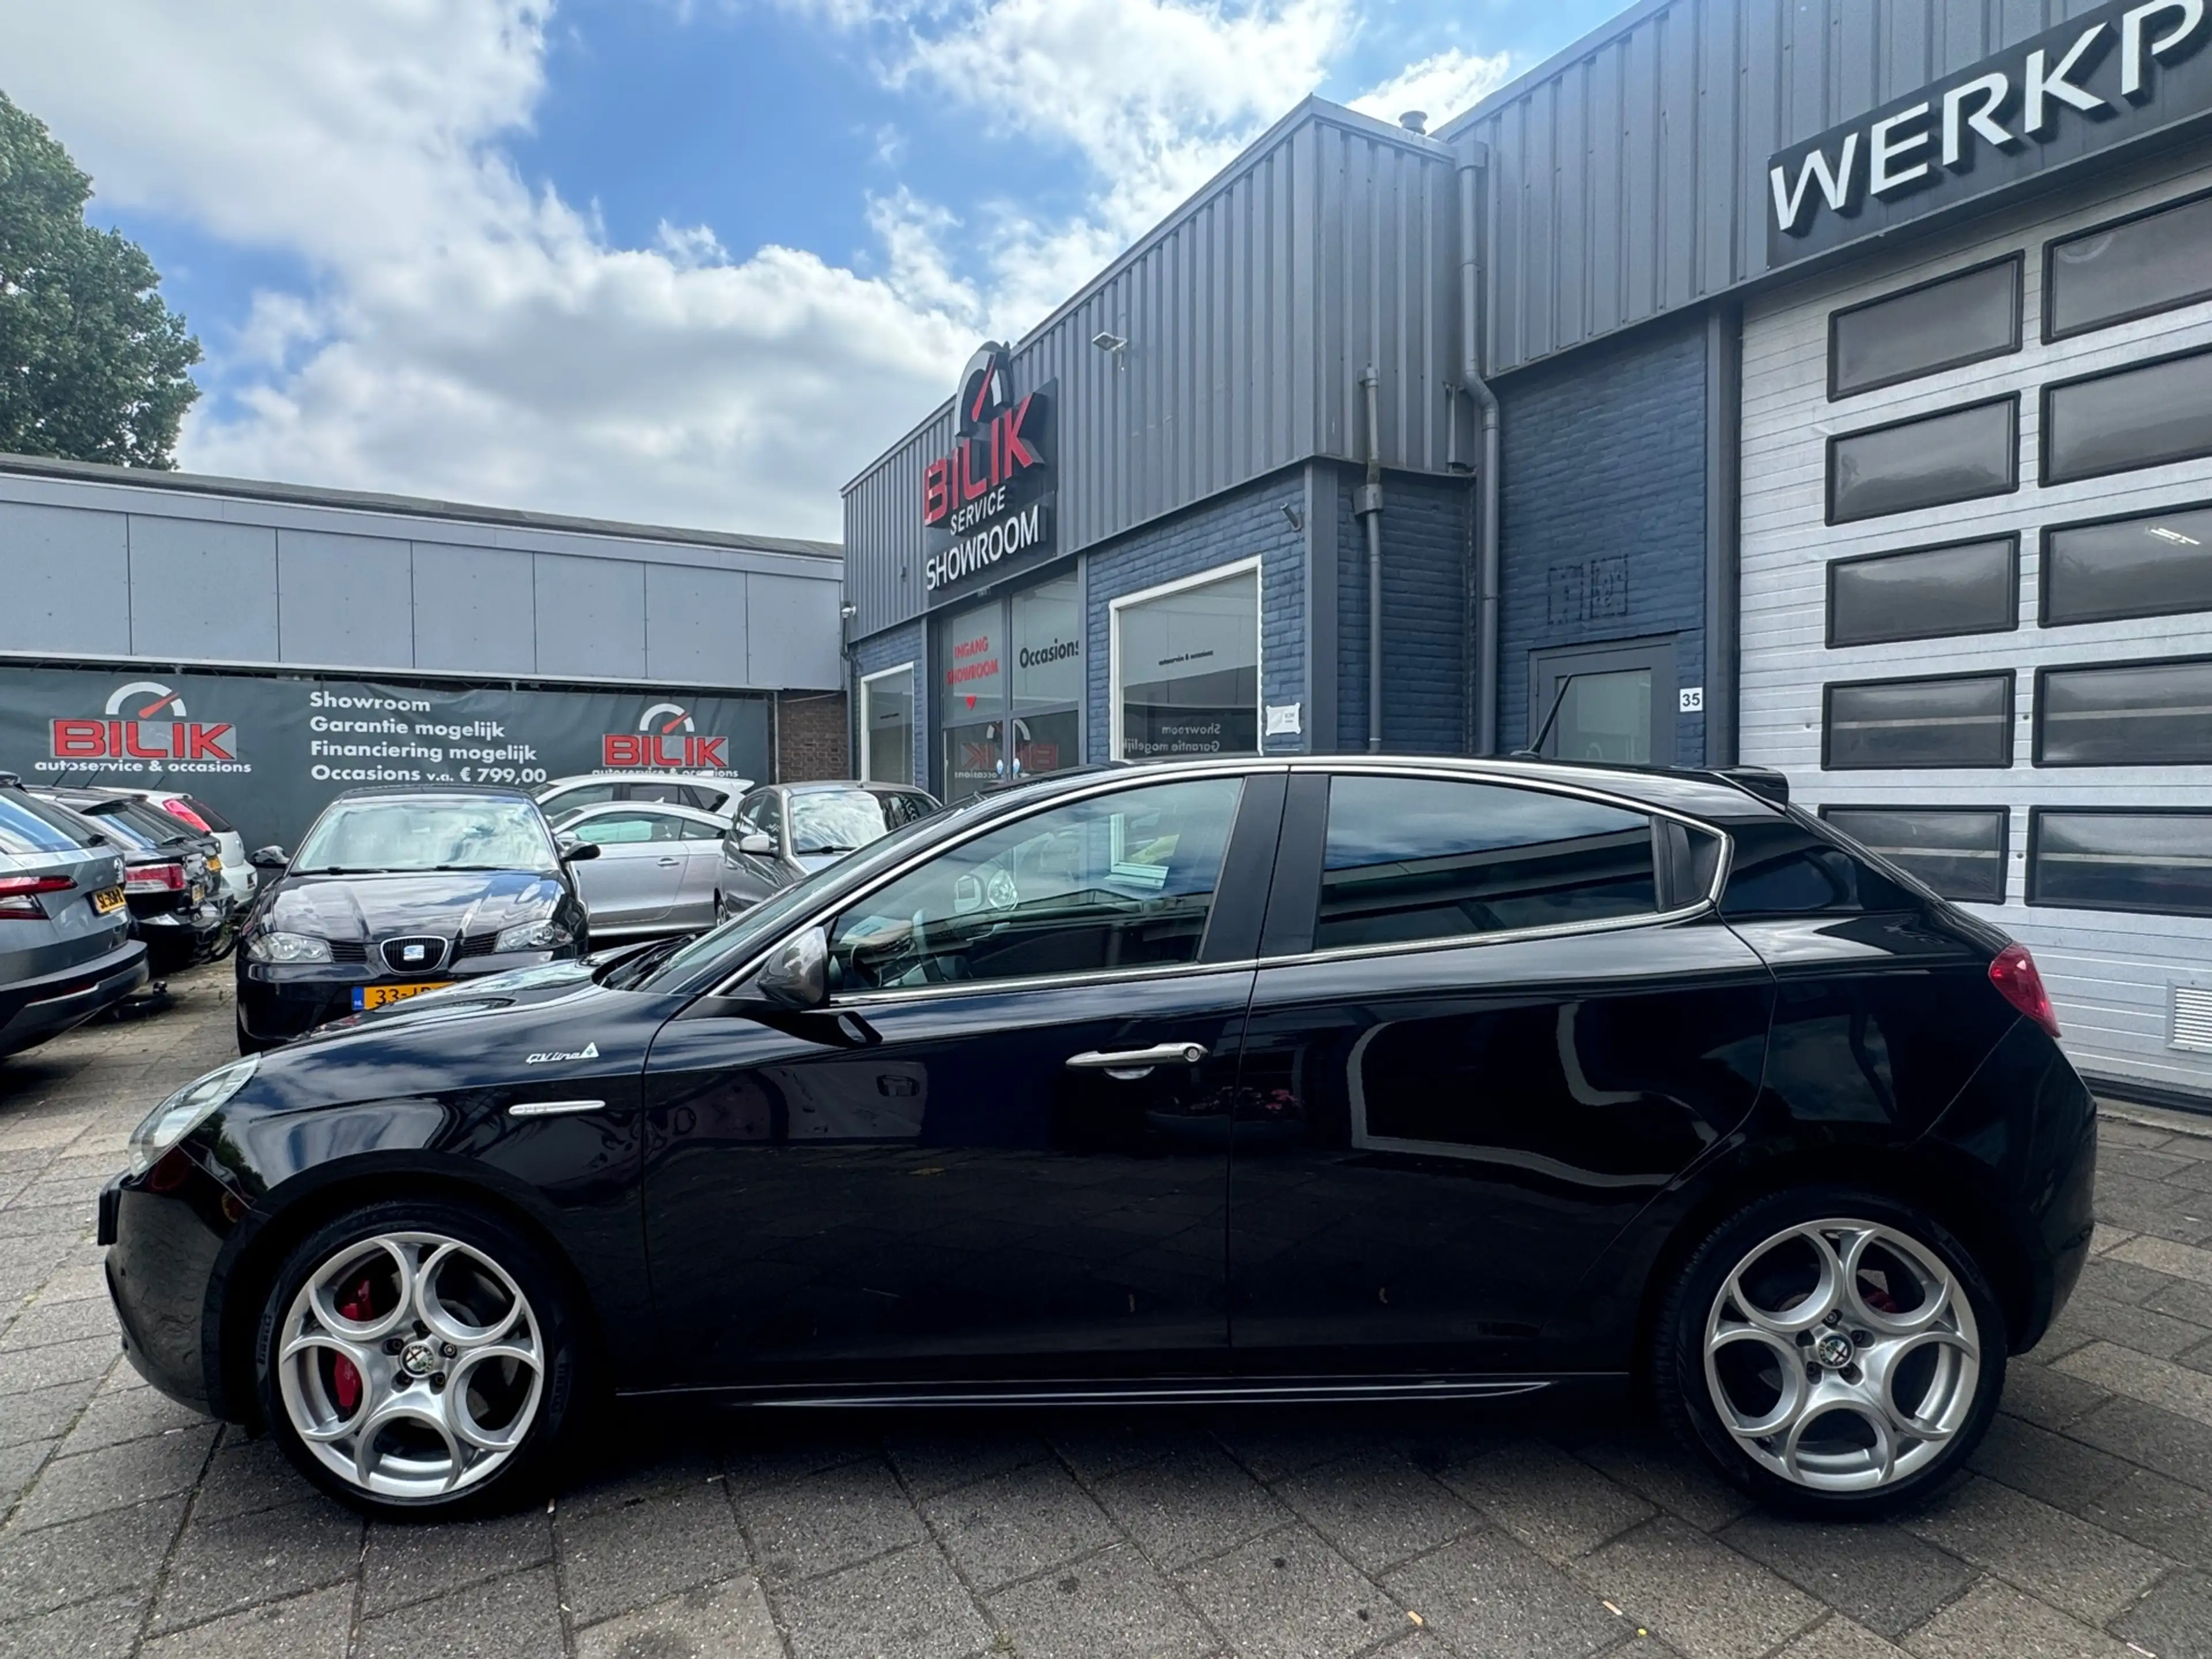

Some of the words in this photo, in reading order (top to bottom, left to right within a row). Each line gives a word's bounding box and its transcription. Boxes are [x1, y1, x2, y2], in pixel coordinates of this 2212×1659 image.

[1770, 0, 2204, 230] WERKP
[924, 393, 1034, 527] BILIK
[950, 486, 1006, 536] SERVICE
[926, 503, 1039, 590] SHOWROOM
[954, 636, 989, 660] INGANG
[946, 658, 999, 685] SHOWROOM
[310, 691, 430, 711] Showroom
[1682, 693, 1700, 707] 35
[54, 720, 235, 760] BILIK
[310, 716, 408, 733] Garantie
[415, 721, 505, 741] mogelijk
[311, 740, 442, 762] Financiering
[449, 745, 537, 764] mogelijk
[605, 735, 727, 767] BILIK
[35, 760, 143, 772] autoservice
[149, 760, 163, 772] &
[168, 760, 252, 773] occasions
[311, 764, 421, 781] Occasions
[426, 774, 454, 782] v.a.
[460, 767, 471, 782] €
[477, 767, 547, 785] 799,00
